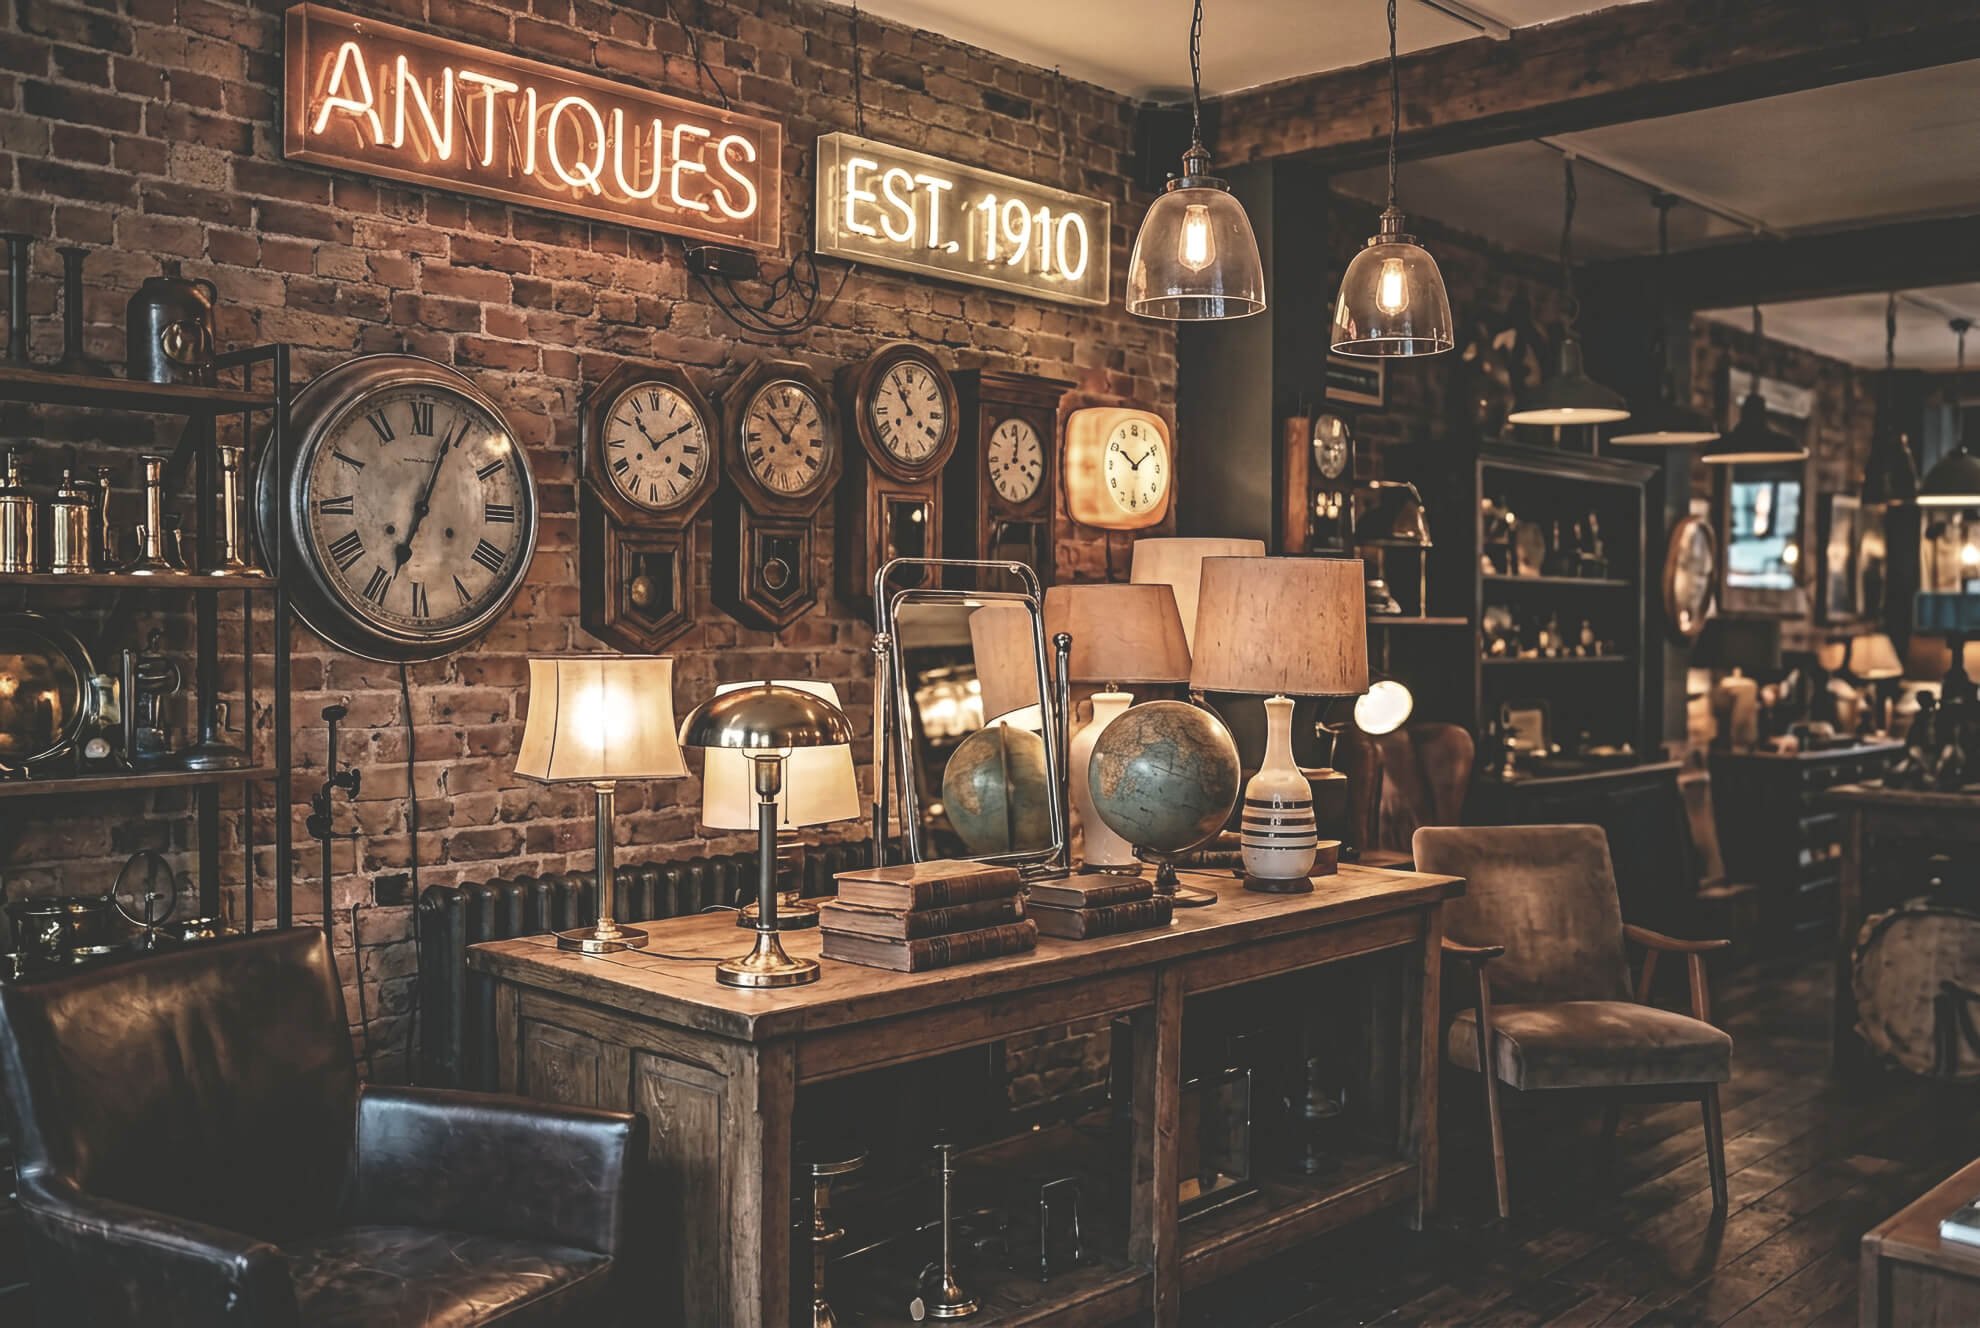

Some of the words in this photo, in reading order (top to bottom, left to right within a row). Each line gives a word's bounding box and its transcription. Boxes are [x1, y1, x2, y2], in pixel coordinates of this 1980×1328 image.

[313, 41, 757, 220] ANTIQUES
[846, 157, 960, 254] EST.
[977, 193, 1089, 281] 1910
[410, 401, 434, 436] XII
[453, 420, 472, 448] I
[485, 503, 515, 524] III
[410, 580, 430, 618] VI
[453, 574, 473, 606] V
